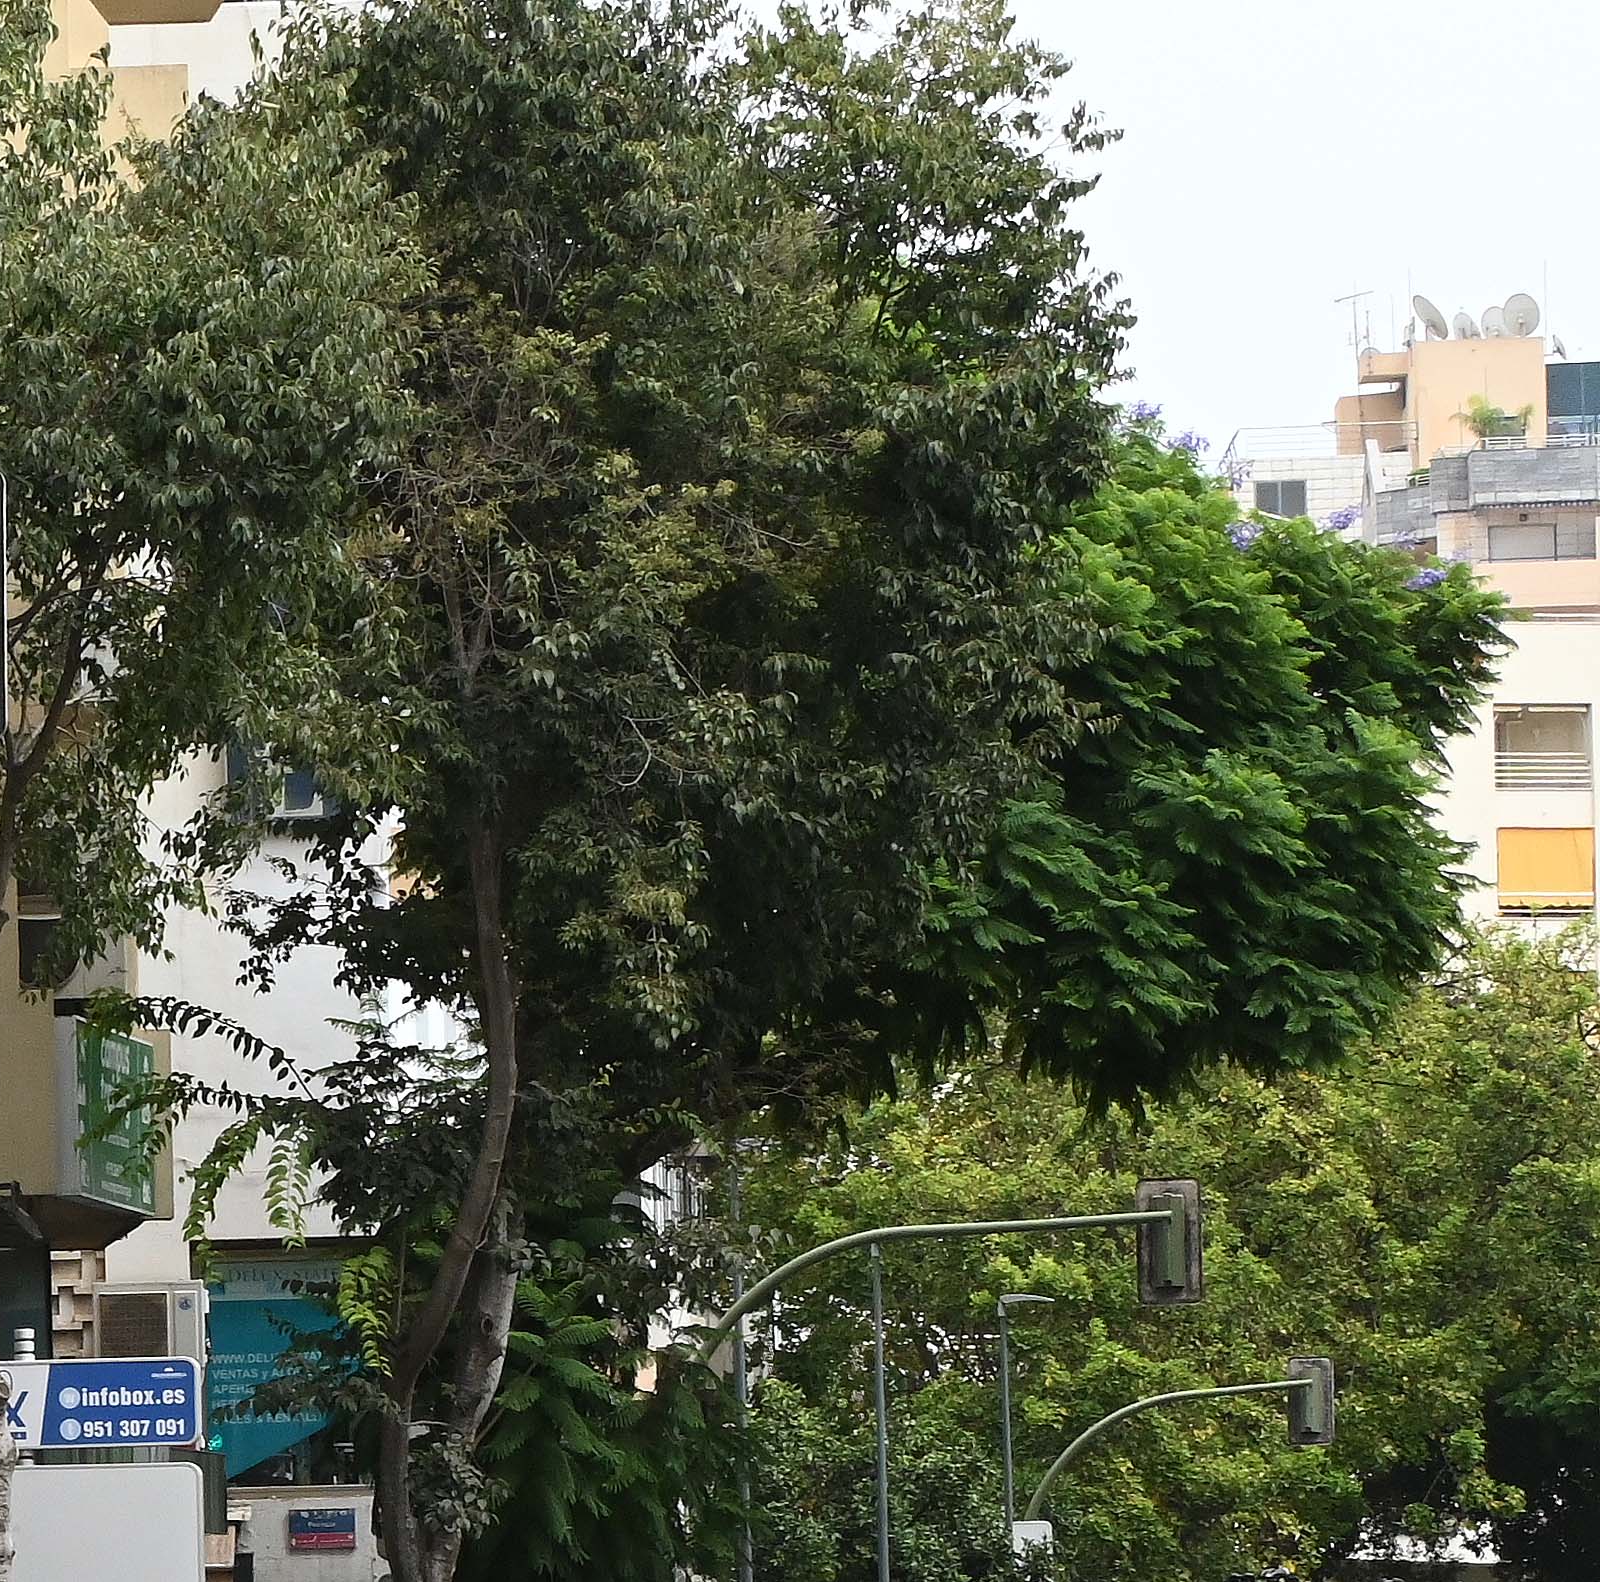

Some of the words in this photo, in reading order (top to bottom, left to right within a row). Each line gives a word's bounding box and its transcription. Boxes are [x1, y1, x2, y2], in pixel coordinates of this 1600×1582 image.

[212, 1369, 259, 1380] VENTAS
[82, 1387, 186, 1407] infobox.es
[83, 1420, 112, 1438] 951
[120, 1420, 150, 1437] 307
[156, 1418, 186, 1435] 091
